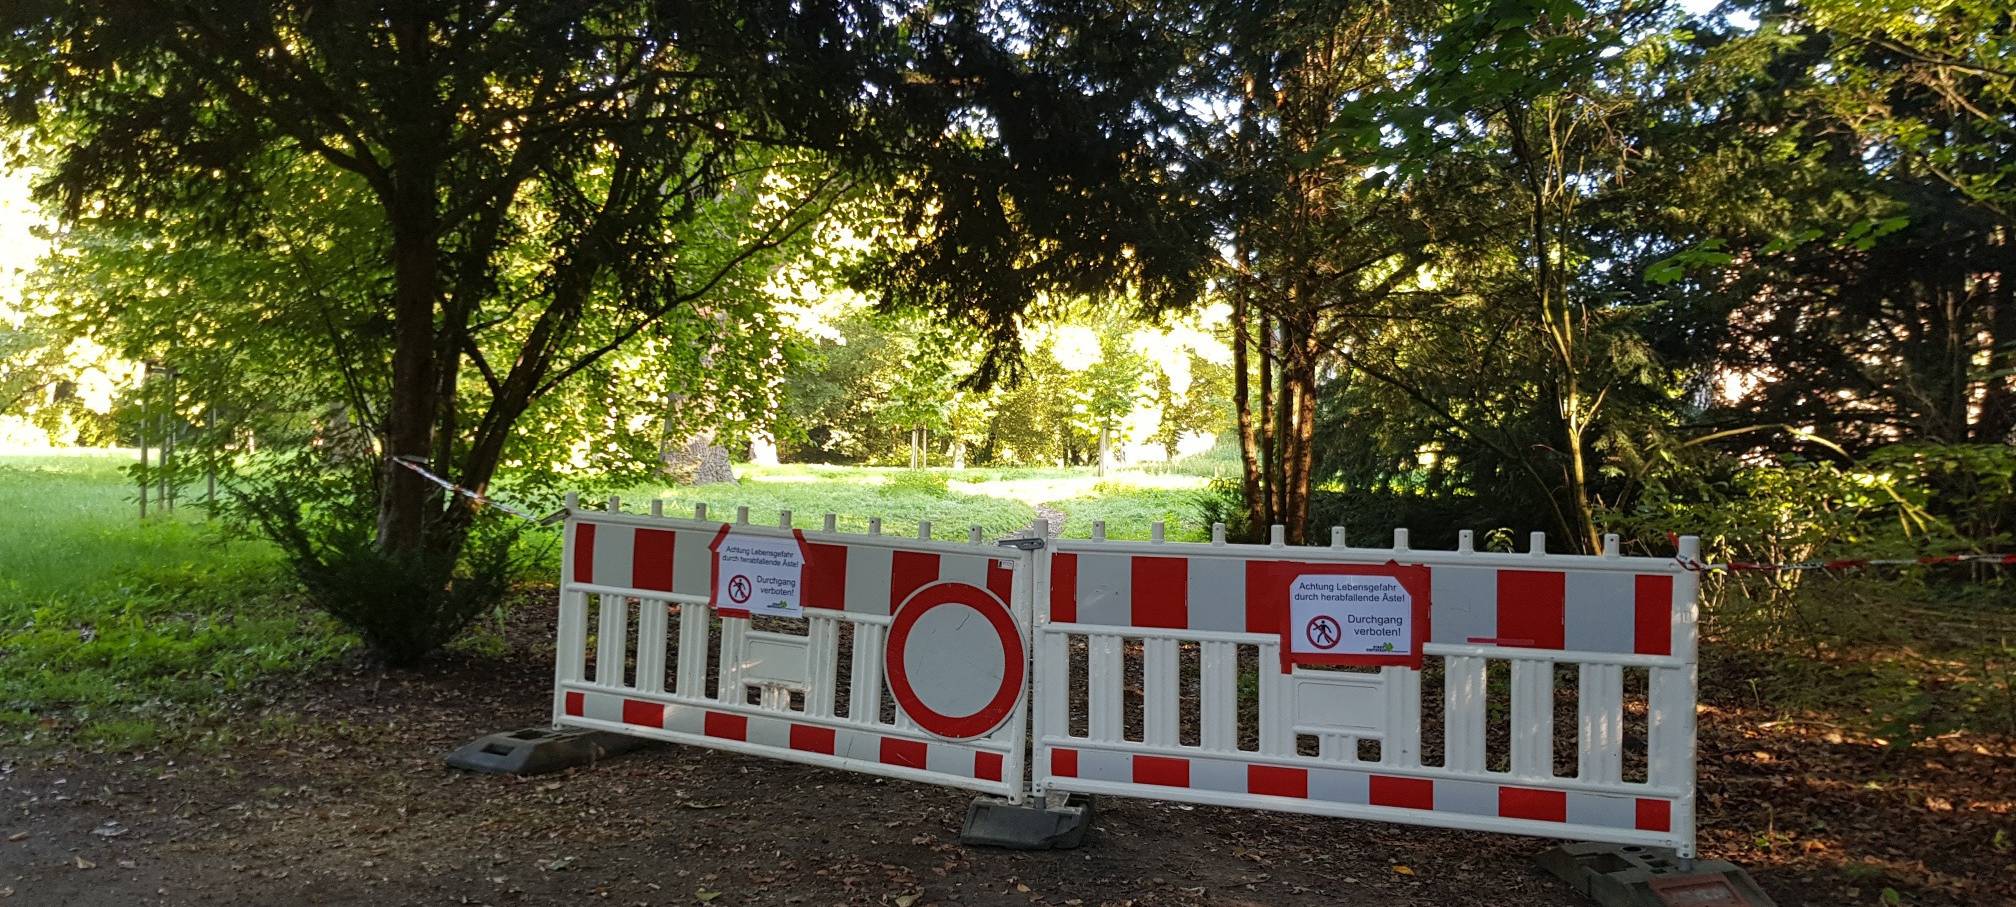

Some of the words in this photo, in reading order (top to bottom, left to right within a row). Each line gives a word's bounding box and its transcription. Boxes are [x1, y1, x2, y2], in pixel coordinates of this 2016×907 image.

[751, 548, 794, 559] Lebensgefahr
[756, 575, 796, 588] Durchgang
[760, 587, 794, 596] verboten!
[1299, 582, 1334, 592] Achtung
[1336, 583, 1396, 592] Lebensgefahr
[1294, 593, 1318, 601] durch
[1320, 593, 1380, 602] herabfallende
[1382, 593, 1405, 602] Äste!
[1347, 614, 1403, 626] Durchgang
[1353, 627, 1401, 637] verboten!
